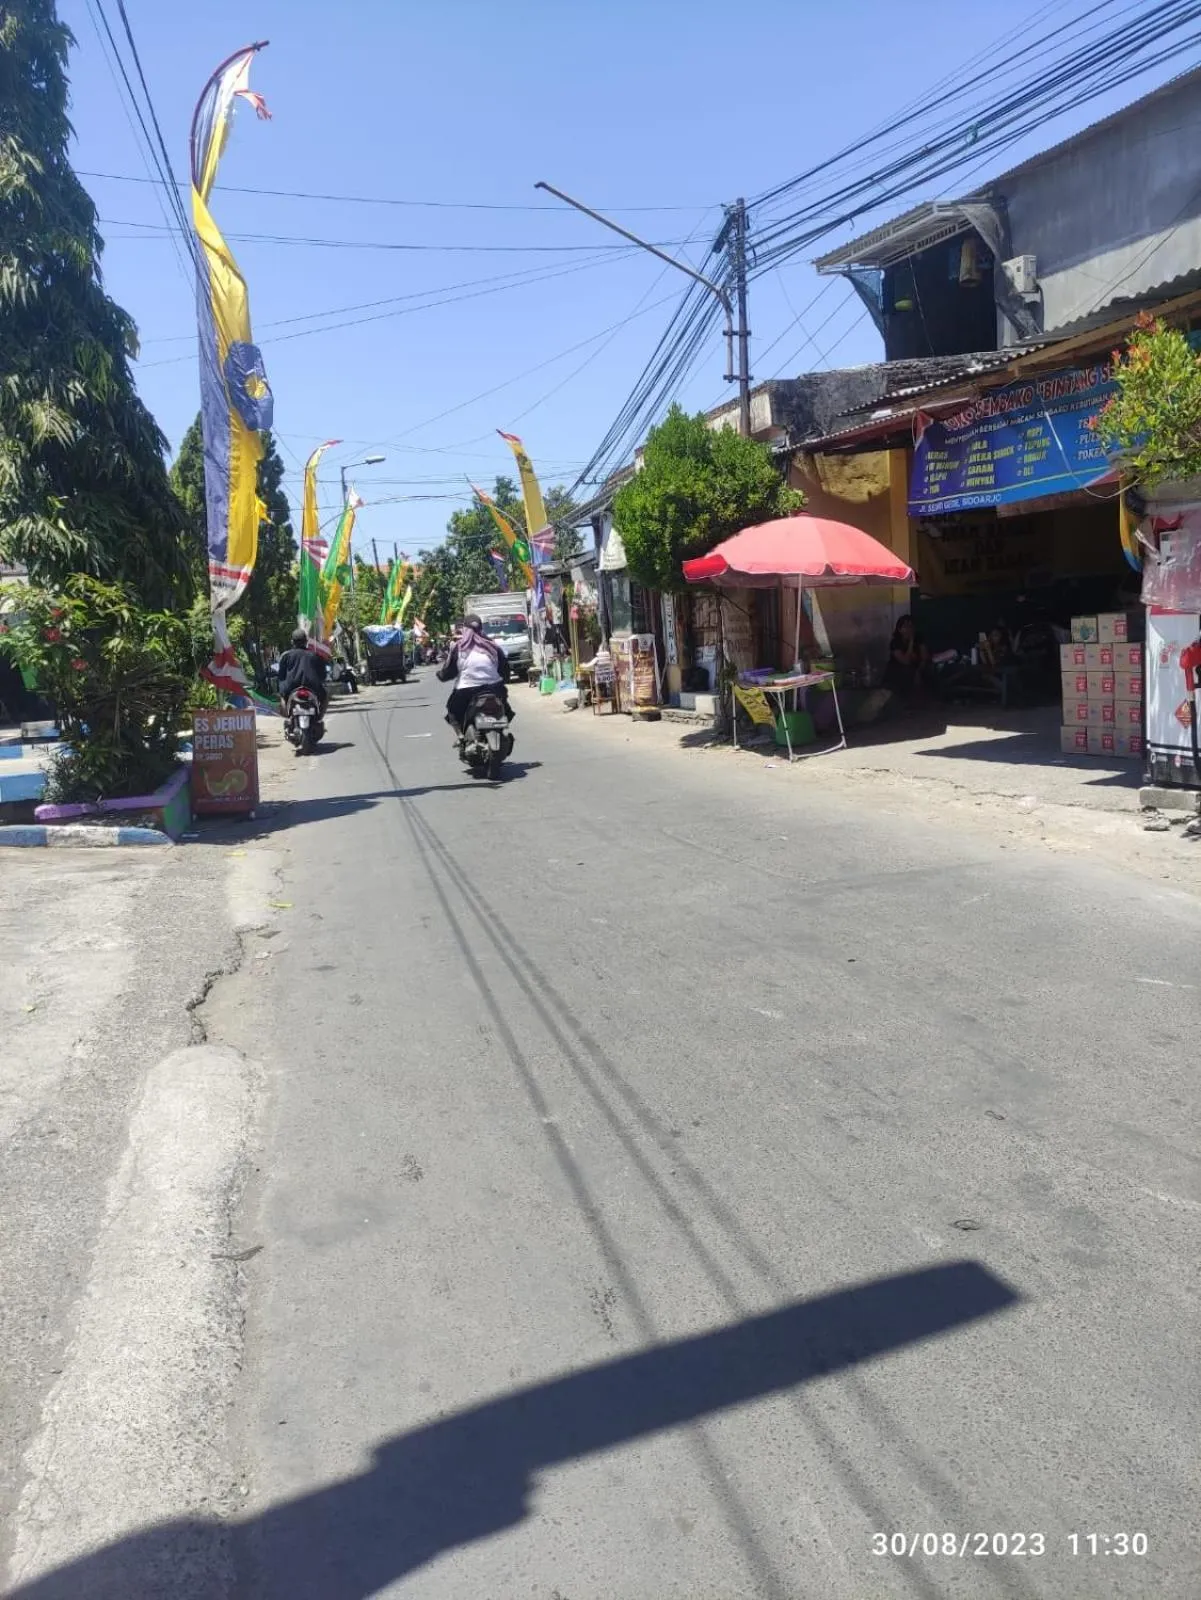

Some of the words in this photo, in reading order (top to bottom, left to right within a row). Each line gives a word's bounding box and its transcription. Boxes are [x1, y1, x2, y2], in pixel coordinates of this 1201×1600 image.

[975, 388, 1033, 419] SEMBAKO
[194, 717, 209, 732] ES
[212, 715, 252, 732] JERUK
[194, 734, 234, 750] PERAS
